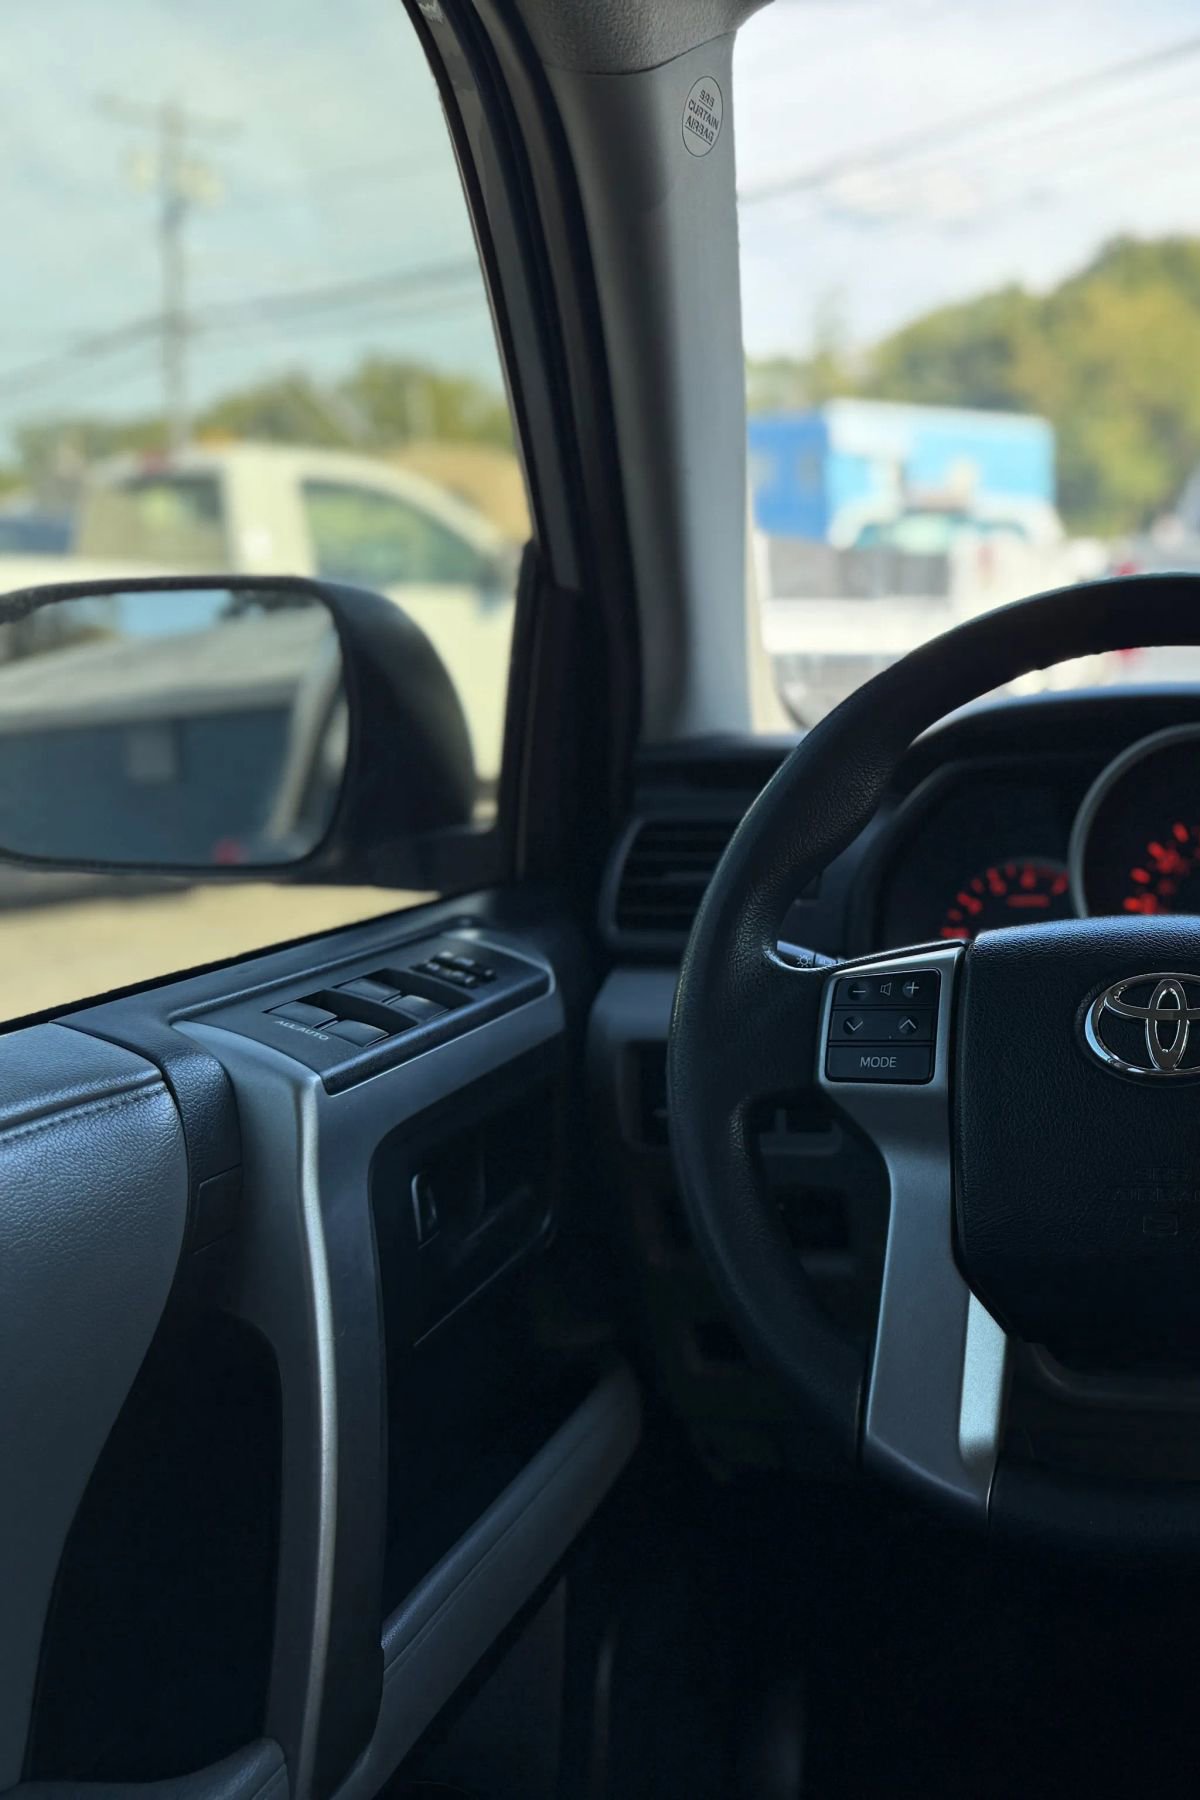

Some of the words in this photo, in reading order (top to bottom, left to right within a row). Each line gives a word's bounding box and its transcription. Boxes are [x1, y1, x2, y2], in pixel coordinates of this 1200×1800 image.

[688, 99, 720, 130] CURTAIN
[685, 115, 715, 142] AIRBAG
[295, 1027, 329, 1041] AUTO
[860, 1056, 897, 1068] MODE
